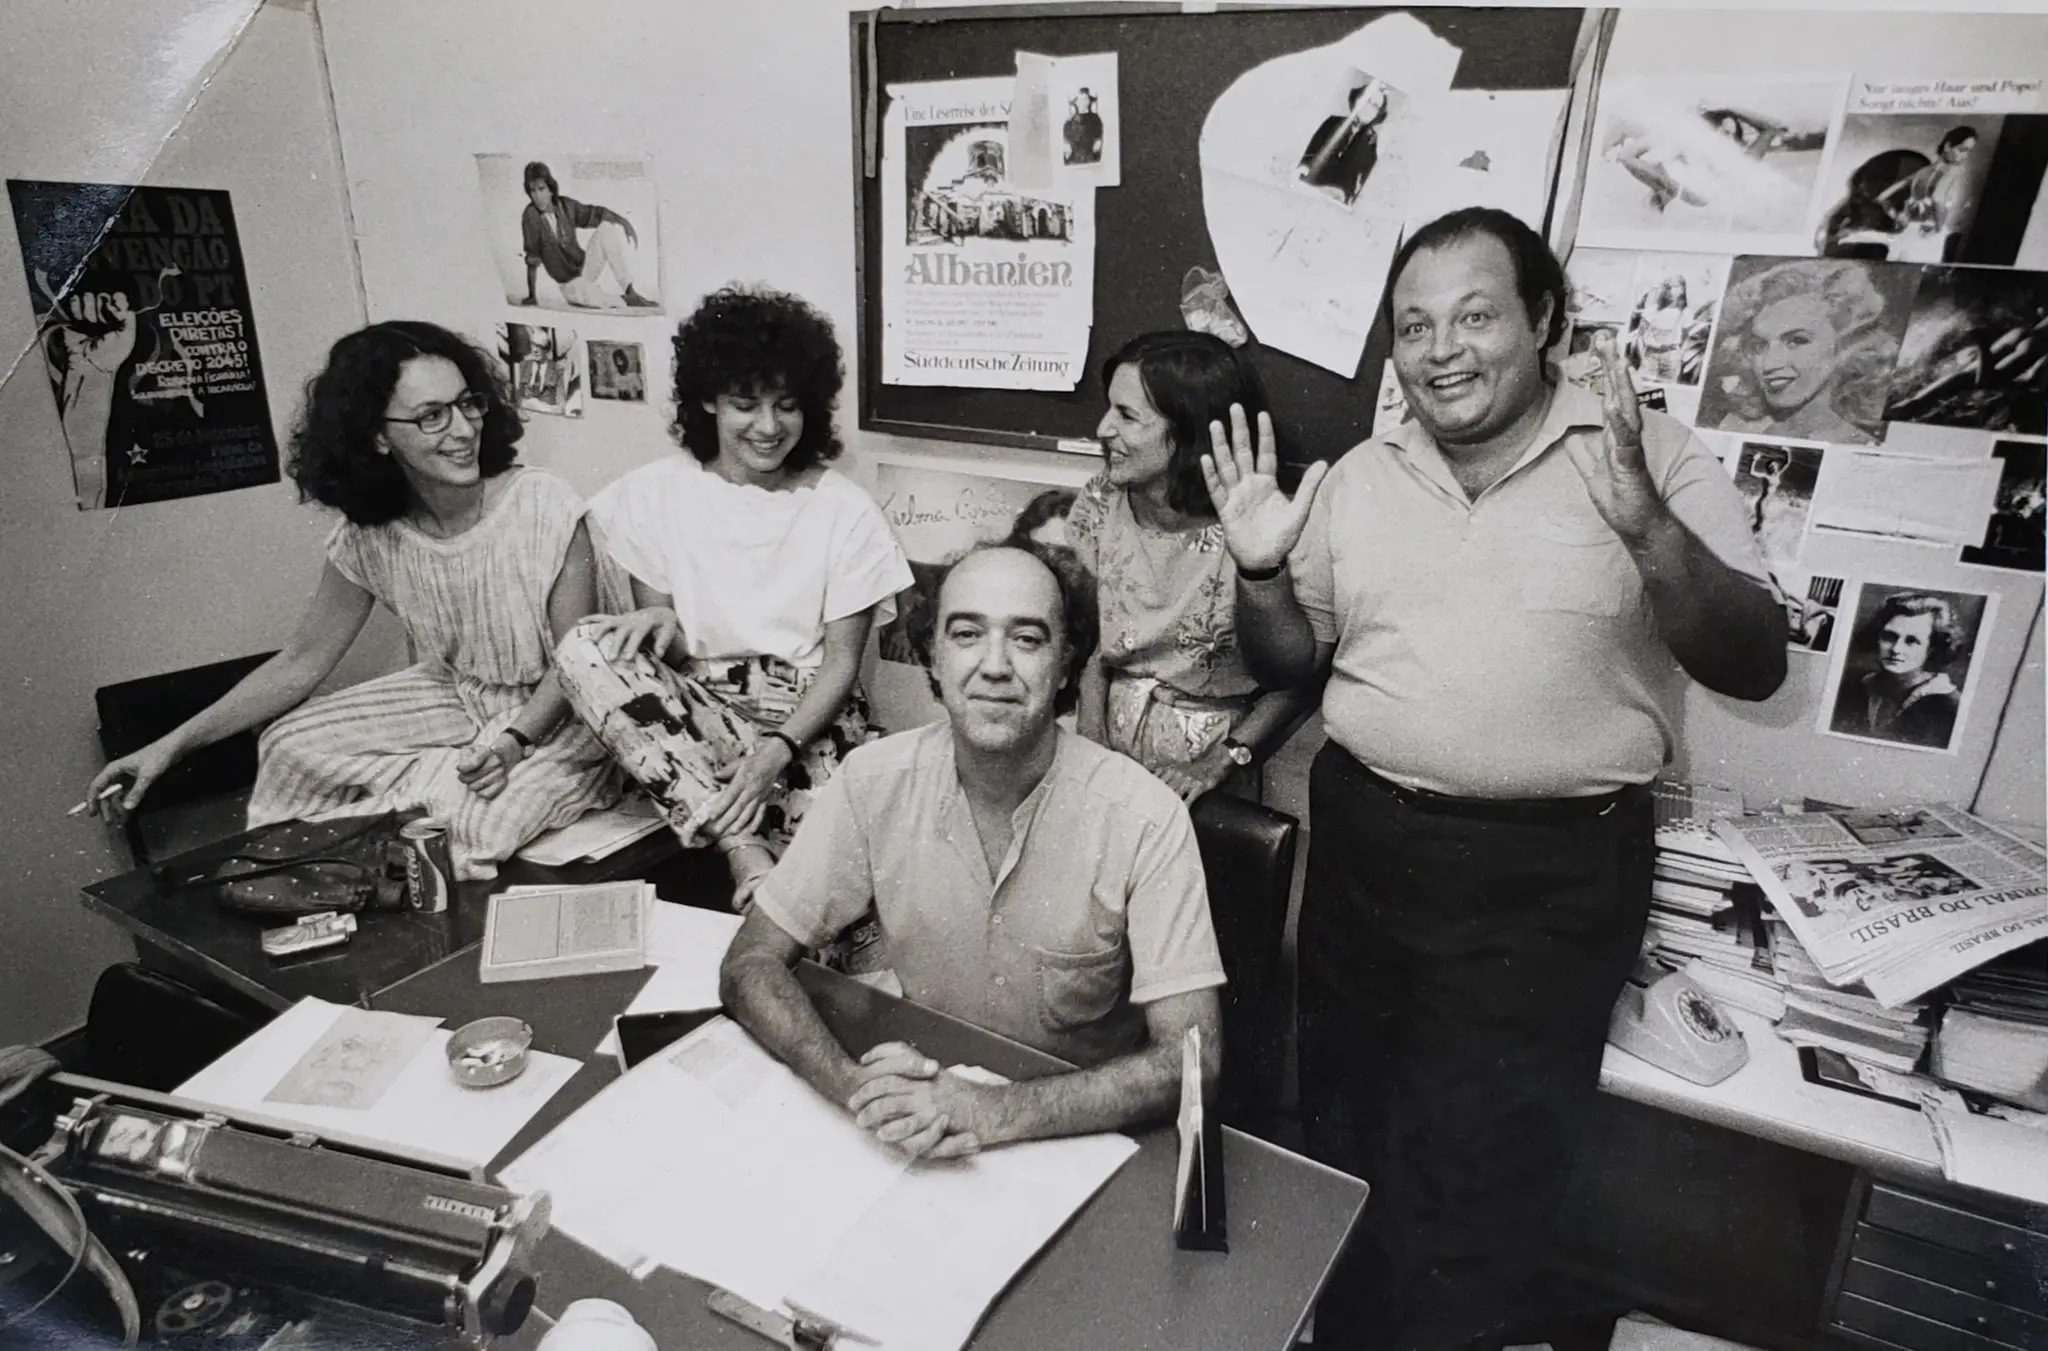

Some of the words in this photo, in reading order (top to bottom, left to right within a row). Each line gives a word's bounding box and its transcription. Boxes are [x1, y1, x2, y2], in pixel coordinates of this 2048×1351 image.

[165, 193, 225, 235] DA
[903, 251, 1074, 288] Albanien
[134, 273, 182, 306] DO
[192, 273, 235, 307] PT
[158, 306, 243, 328] ELEIÇÕES
[1939, 899, 1974, 914] DO
[1974, 885, 2047, 906] ORNAL
[1849, 905, 1937, 944] BRASIL
[2002, 922, 2024, 934] DO
[1950, 927, 2002, 954] BRASIL
